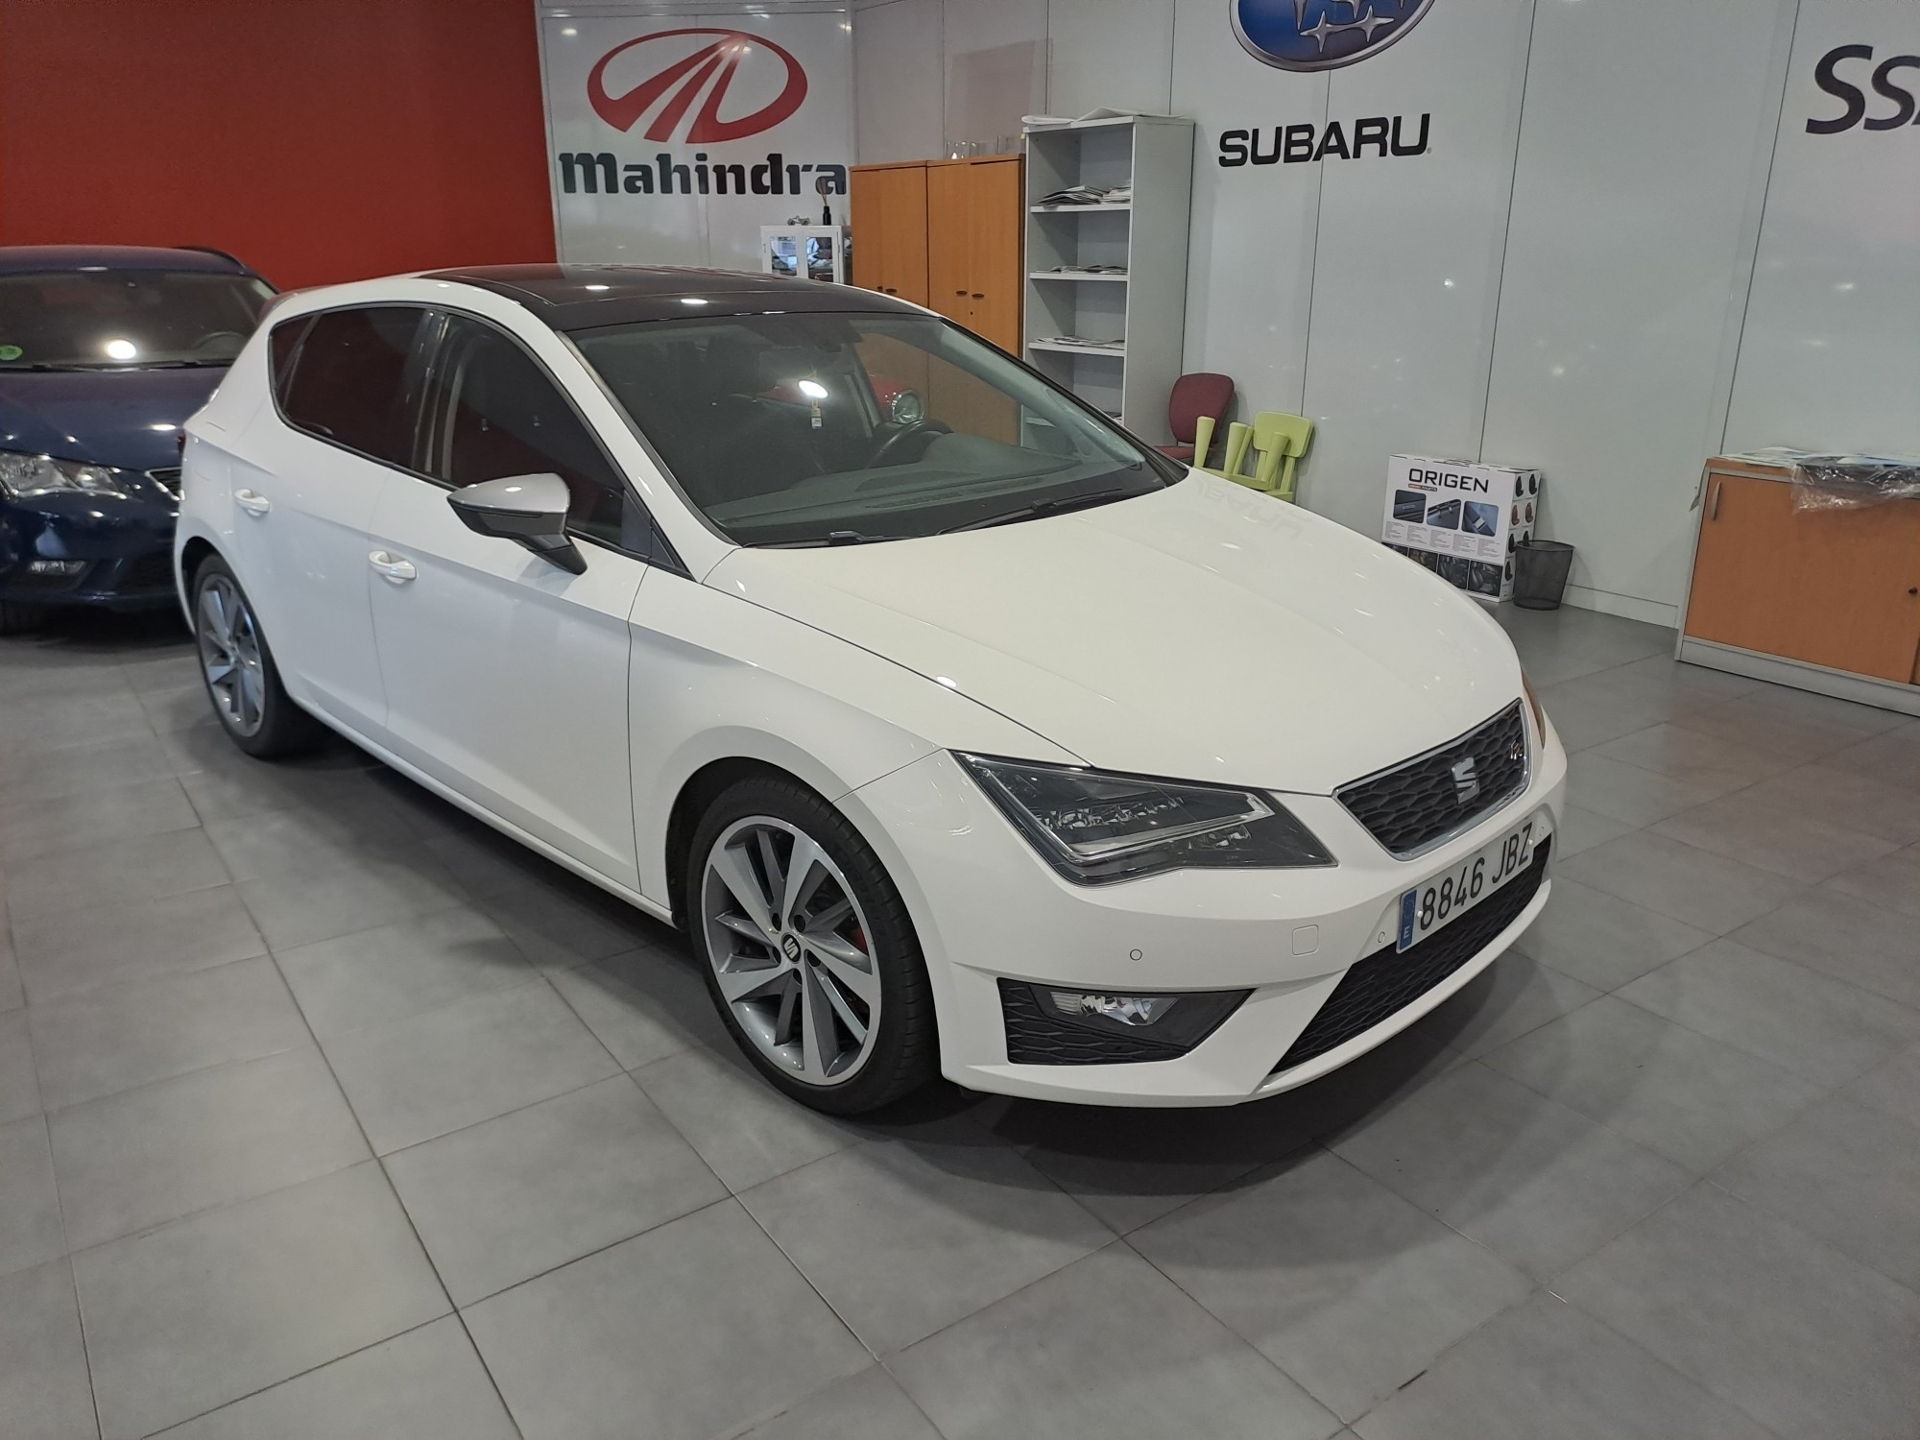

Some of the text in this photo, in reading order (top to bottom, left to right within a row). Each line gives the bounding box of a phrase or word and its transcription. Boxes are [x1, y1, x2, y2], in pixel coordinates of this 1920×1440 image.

[1805, 44, 1920, 134] SS
[1218, 113, 1430, 167] SUBARU
[1409, 468, 1489, 493] ORIGEN
[1420, 856, 1485, 931] 8846
[1492, 821, 1533, 884] JBZ
